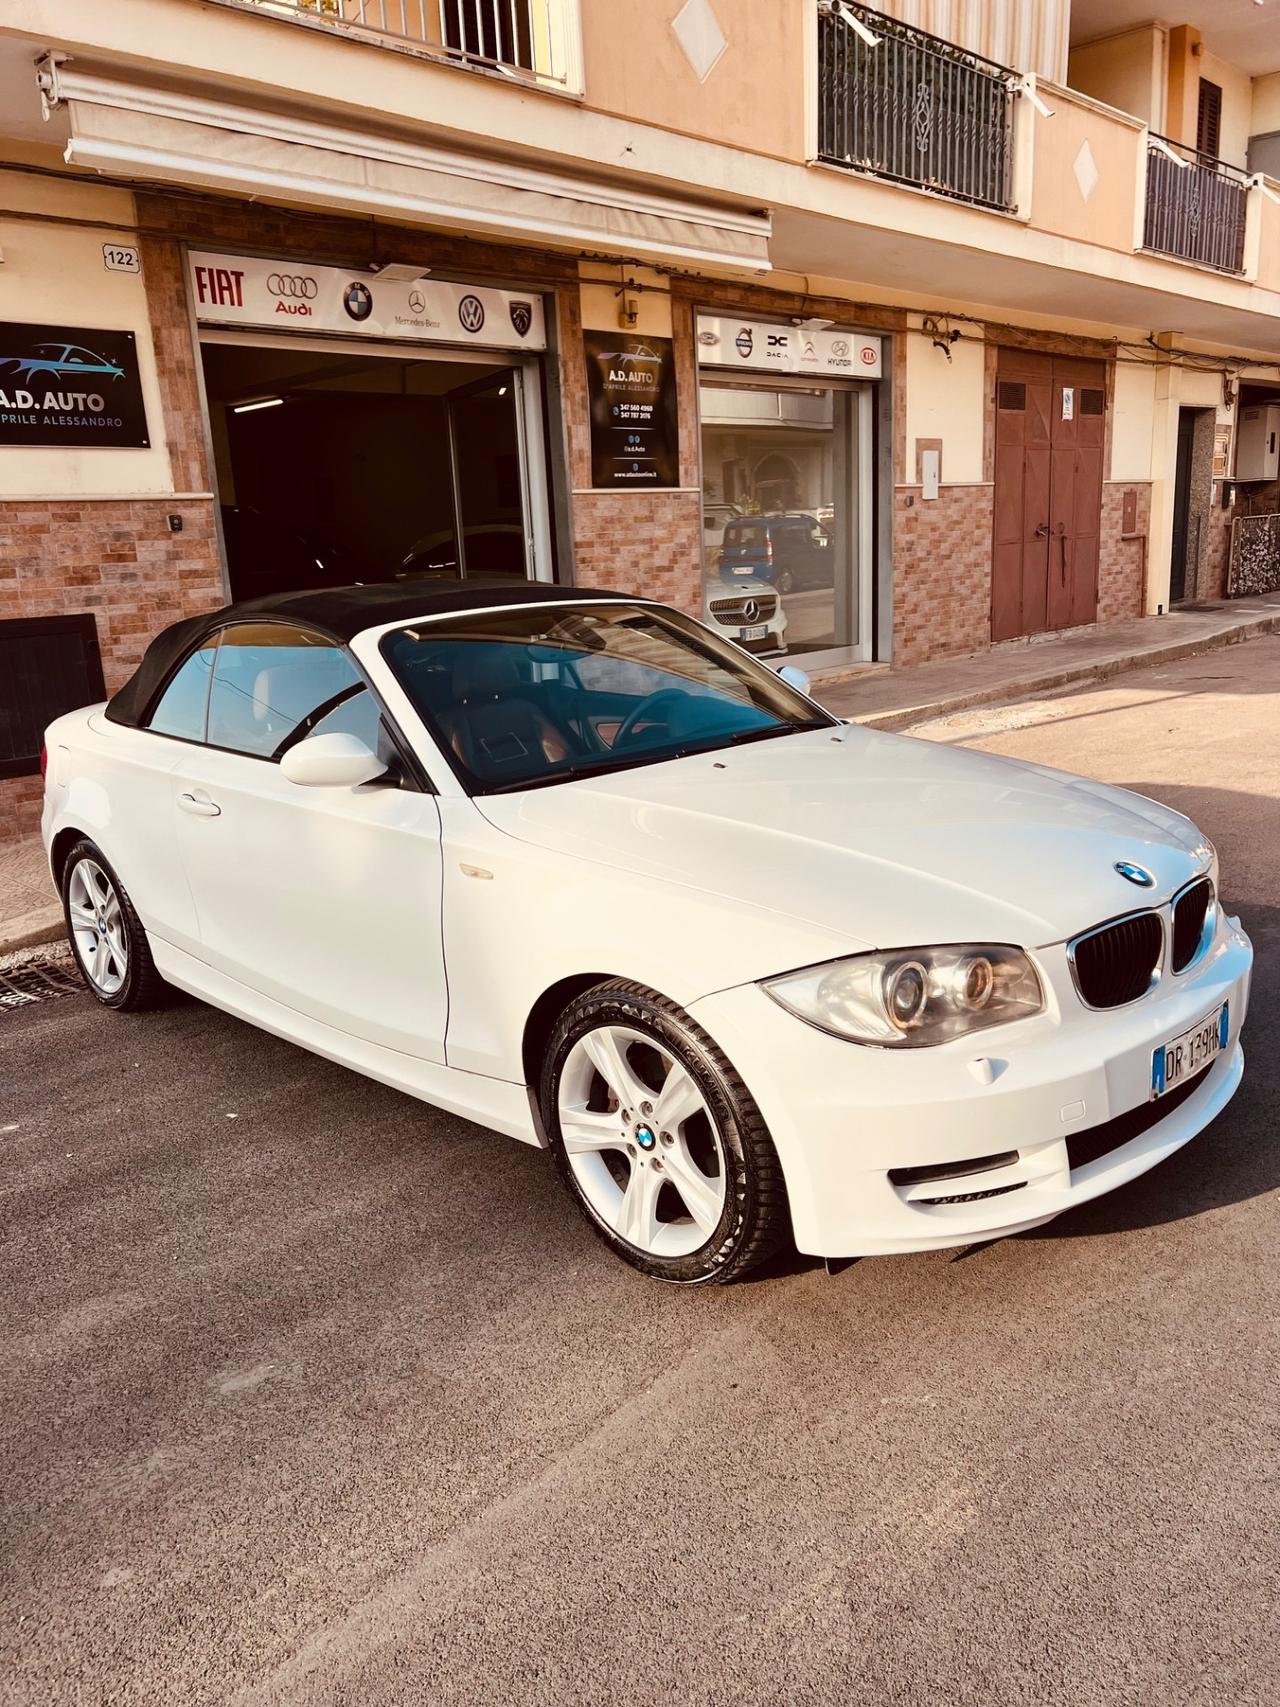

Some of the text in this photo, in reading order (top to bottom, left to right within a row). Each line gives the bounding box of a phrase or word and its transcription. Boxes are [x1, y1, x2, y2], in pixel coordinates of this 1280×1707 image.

[108, 251, 134, 266] 122
[195, 266, 244, 307] FIAT
[275, 301, 312, 316] Audi
[863, 349, 875, 361] KIA
[609, 370, 653, 384] A.D. AUTO
[43, 391, 105, 412] AUTO
[43, 415, 123, 427] ALESSANDRO
[1166, 1046, 1183, 1081] DR
